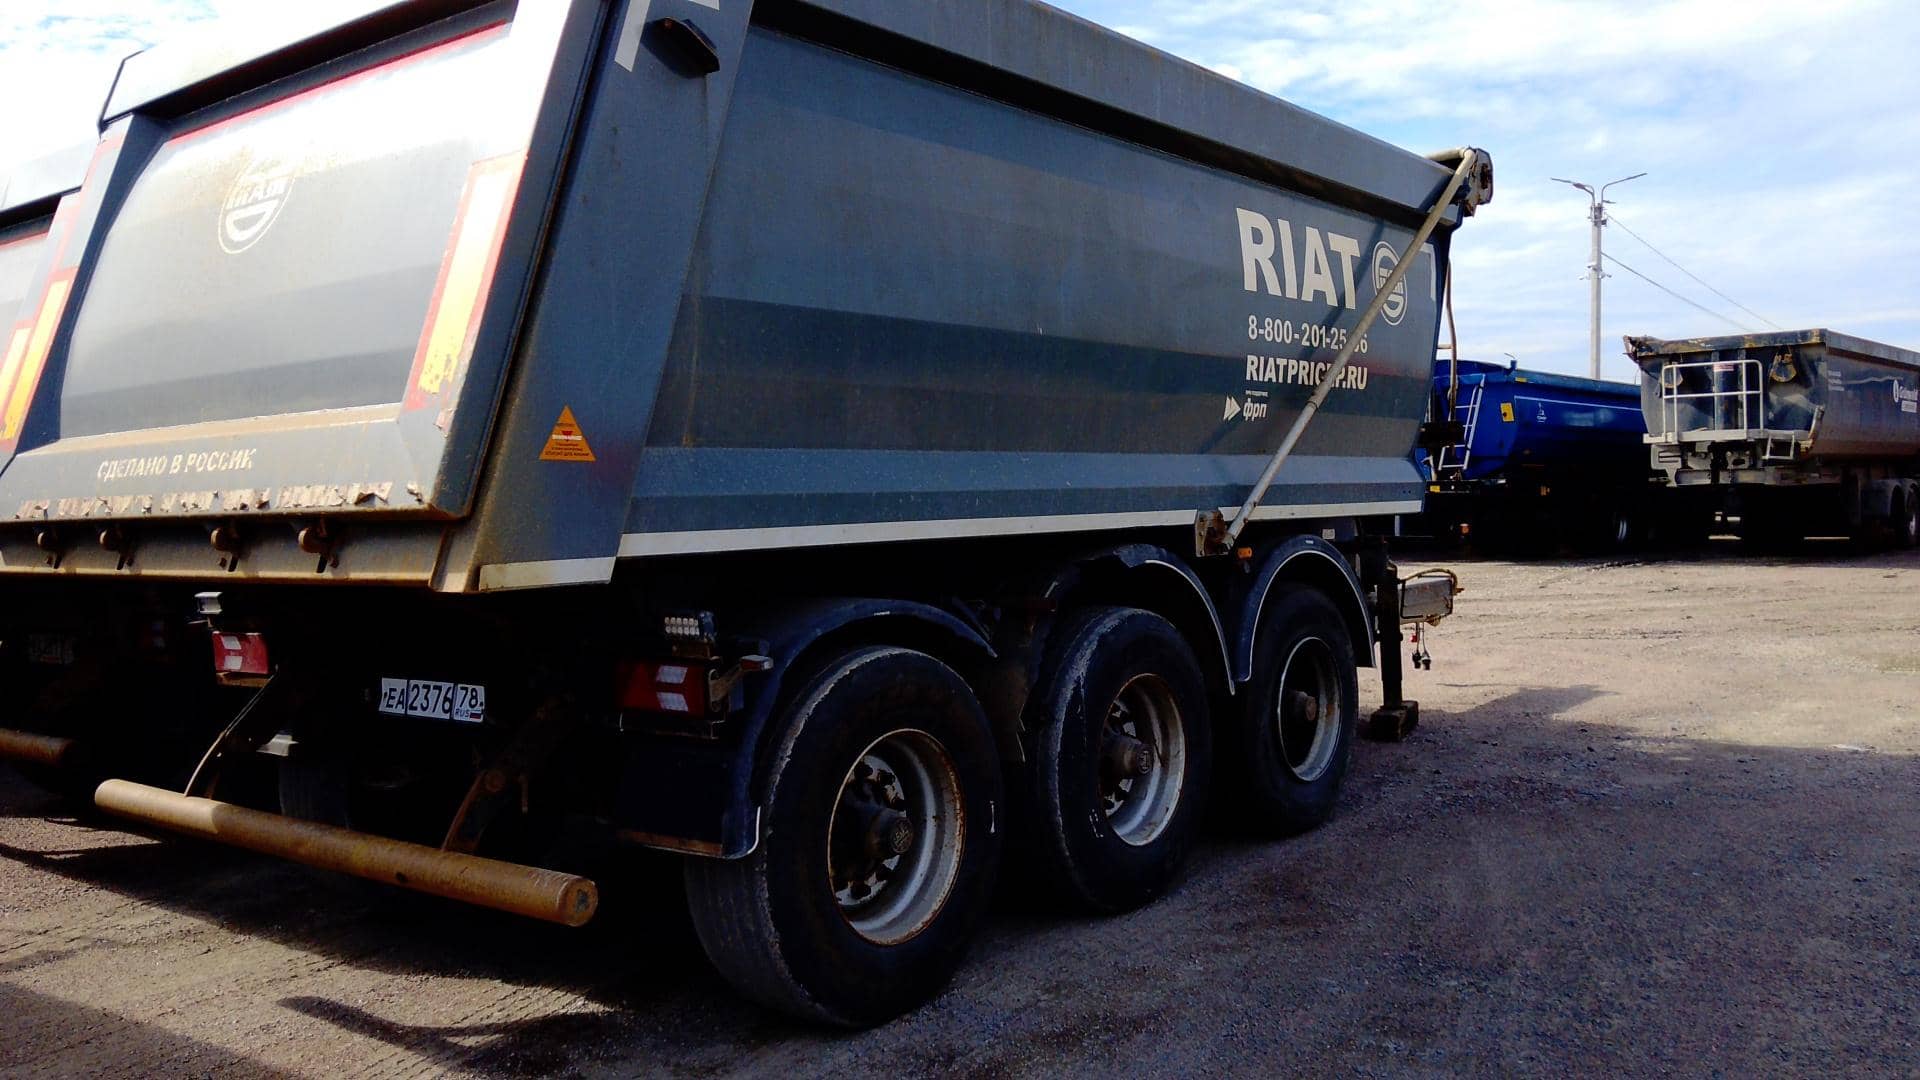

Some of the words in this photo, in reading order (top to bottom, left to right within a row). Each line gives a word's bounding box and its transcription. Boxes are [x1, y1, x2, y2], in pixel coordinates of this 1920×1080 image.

[1236, 207, 1360, 309] RIAT
[1245, 354, 1368, 390] RIATPRICP.RU
[168, 453, 183, 475] В
[408, 683, 454, 715] 2376
[458, 686, 479, 709] 78
